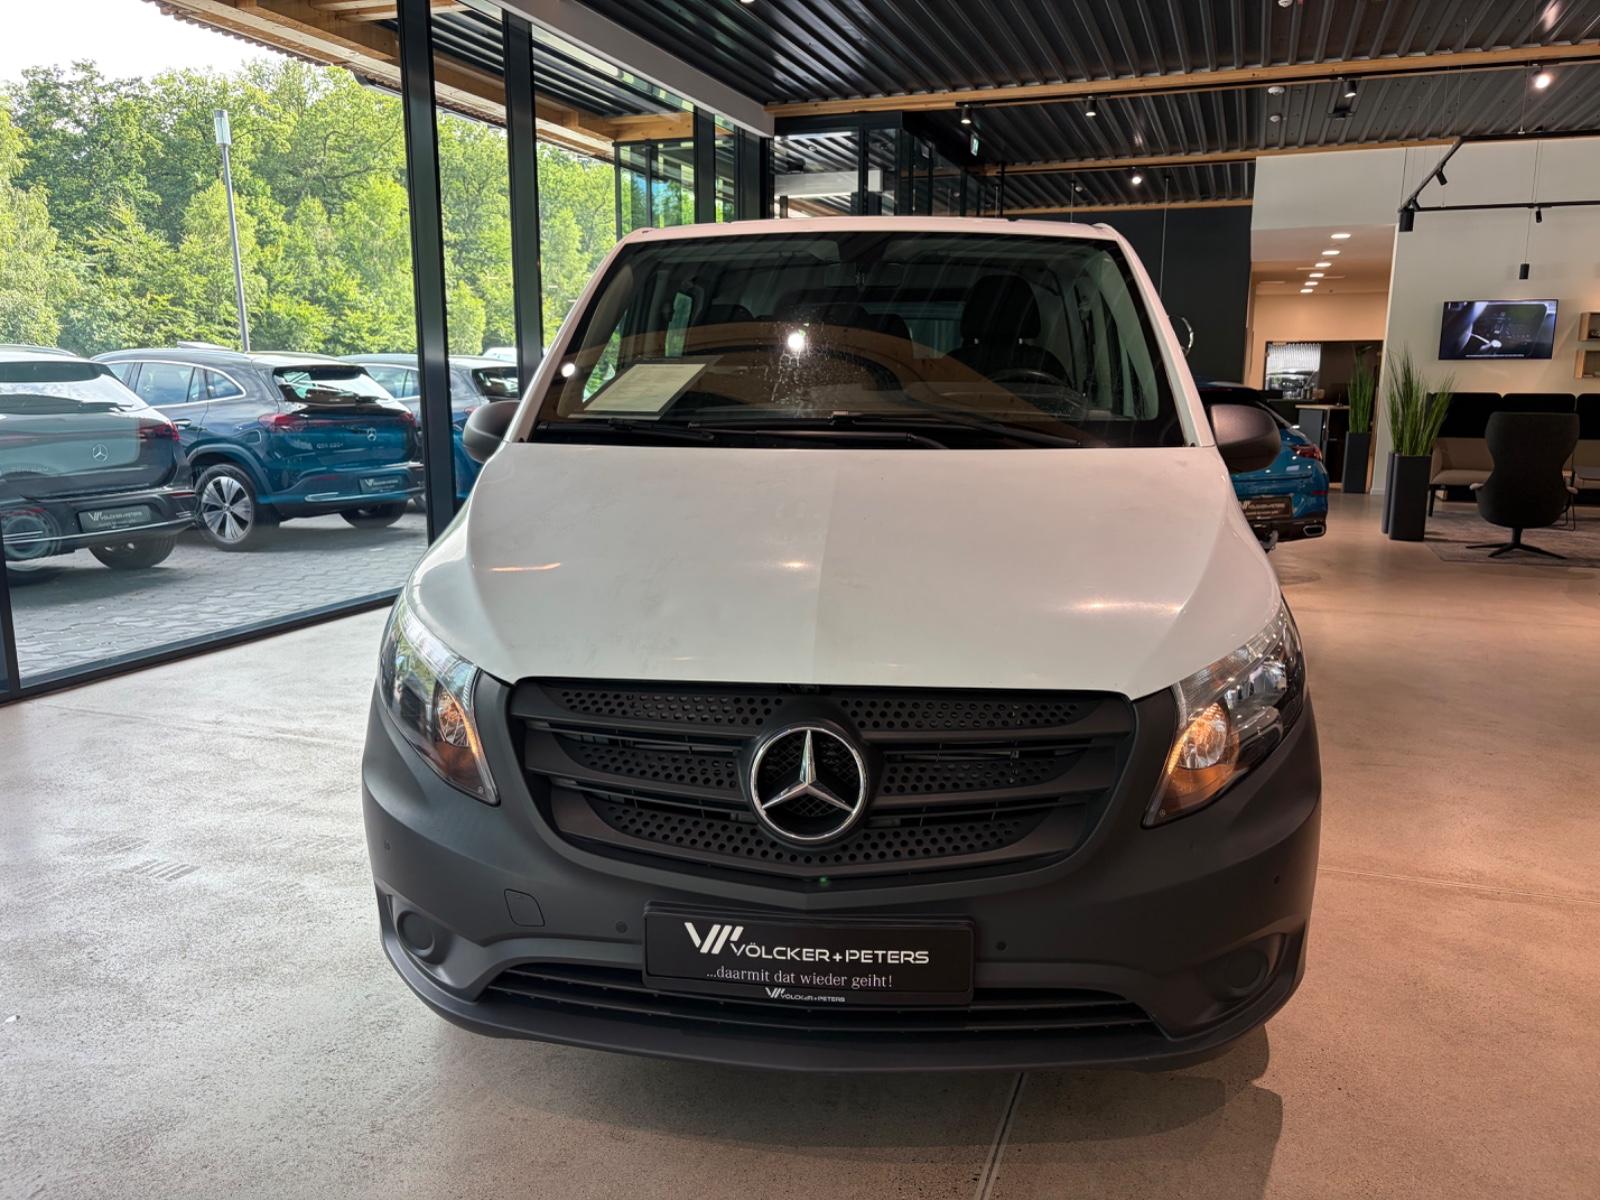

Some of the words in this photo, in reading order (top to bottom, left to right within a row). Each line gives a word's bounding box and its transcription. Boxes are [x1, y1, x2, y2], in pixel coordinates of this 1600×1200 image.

[729, 942, 930, 964] VÖLCKER+PETERS
[774, 969, 796, 985] dat
[800, 971, 848, 987] wieder
[852, 974, 893, 990] geiht!
